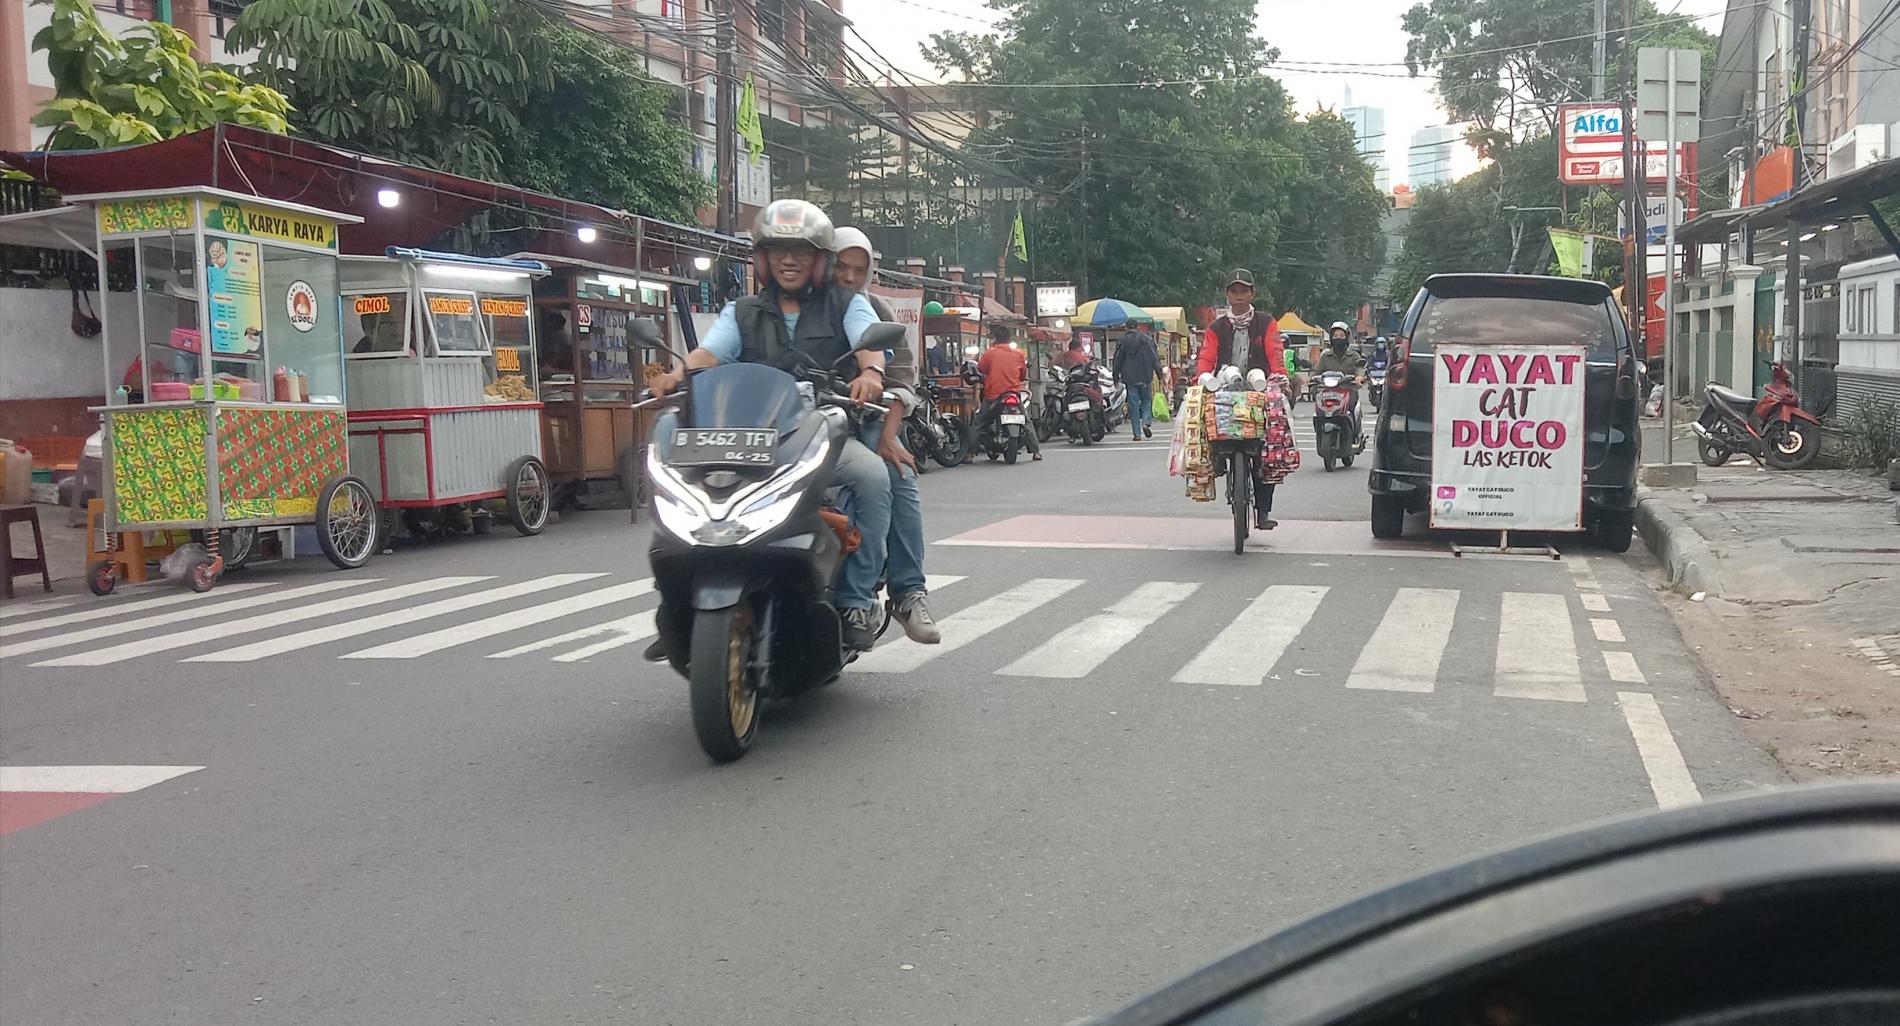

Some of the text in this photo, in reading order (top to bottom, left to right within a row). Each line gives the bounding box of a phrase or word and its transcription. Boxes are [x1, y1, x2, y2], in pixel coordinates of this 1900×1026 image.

[1573, 115, 1619, 133] Alfa
[223, 217, 240, 232] GO
[248, 213, 324, 242] KARYA RAYA
[355, 298, 389, 313] CIMOL
[578, 305, 590, 324] CS
[496, 349, 519, 370] CIMOL
[1441, 354, 1582, 384] YAYAT
[1478, 387, 1537, 420] CAT
[675, 432, 689, 447] B
[695, 432, 738, 446] 5462
[1452, 420, 1567, 450] DUCO
[724, 451, 771, 462] 04-25
[1463, 450, 1552, 469] LAS KETOK
